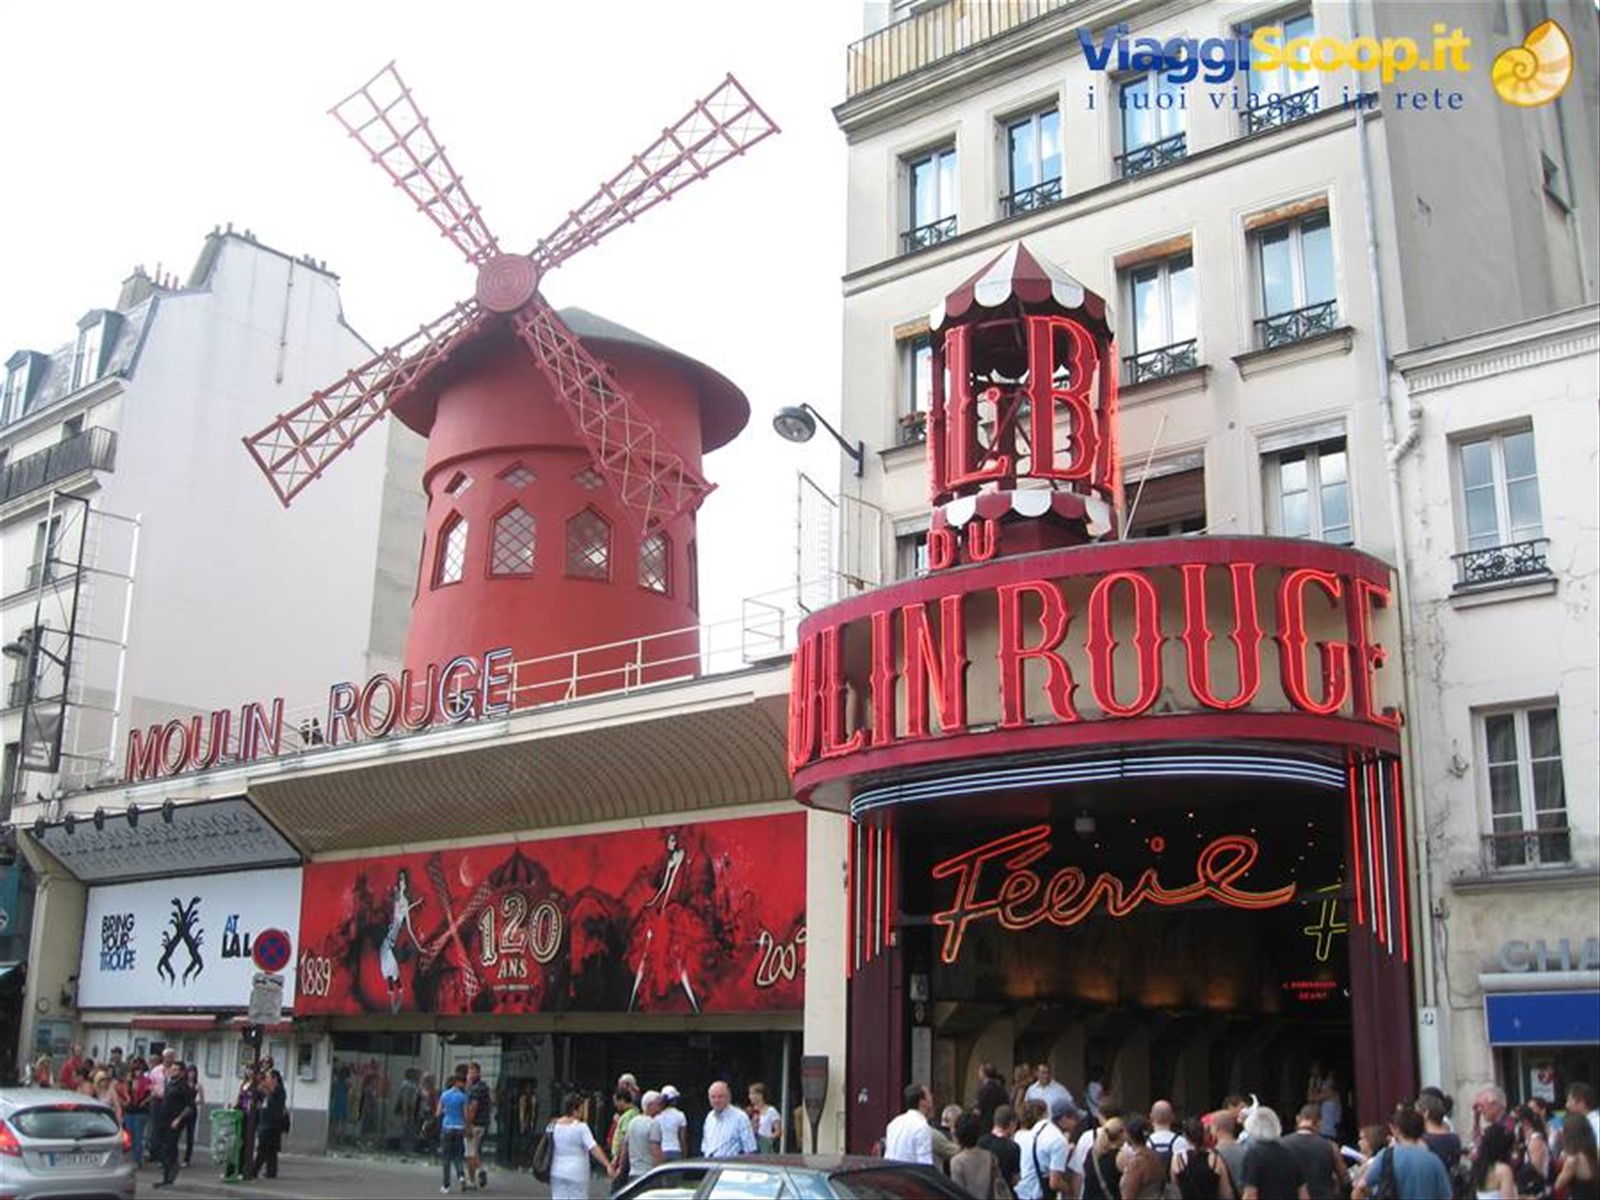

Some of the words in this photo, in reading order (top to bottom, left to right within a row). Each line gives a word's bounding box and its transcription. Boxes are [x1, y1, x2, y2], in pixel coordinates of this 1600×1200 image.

[927, 520, 995, 570] DU
[997, 561, 1403, 731] ROUGE
[125, 697, 284, 783] MOULIN
[326, 647, 513, 746] ROUGE
[102, 913, 135, 933] BRING
[225, 914, 240, 935] AT
[479, 890, 562, 968] 120
[300, 950, 332, 997] 1889
[498, 957, 528, 979] ANS
